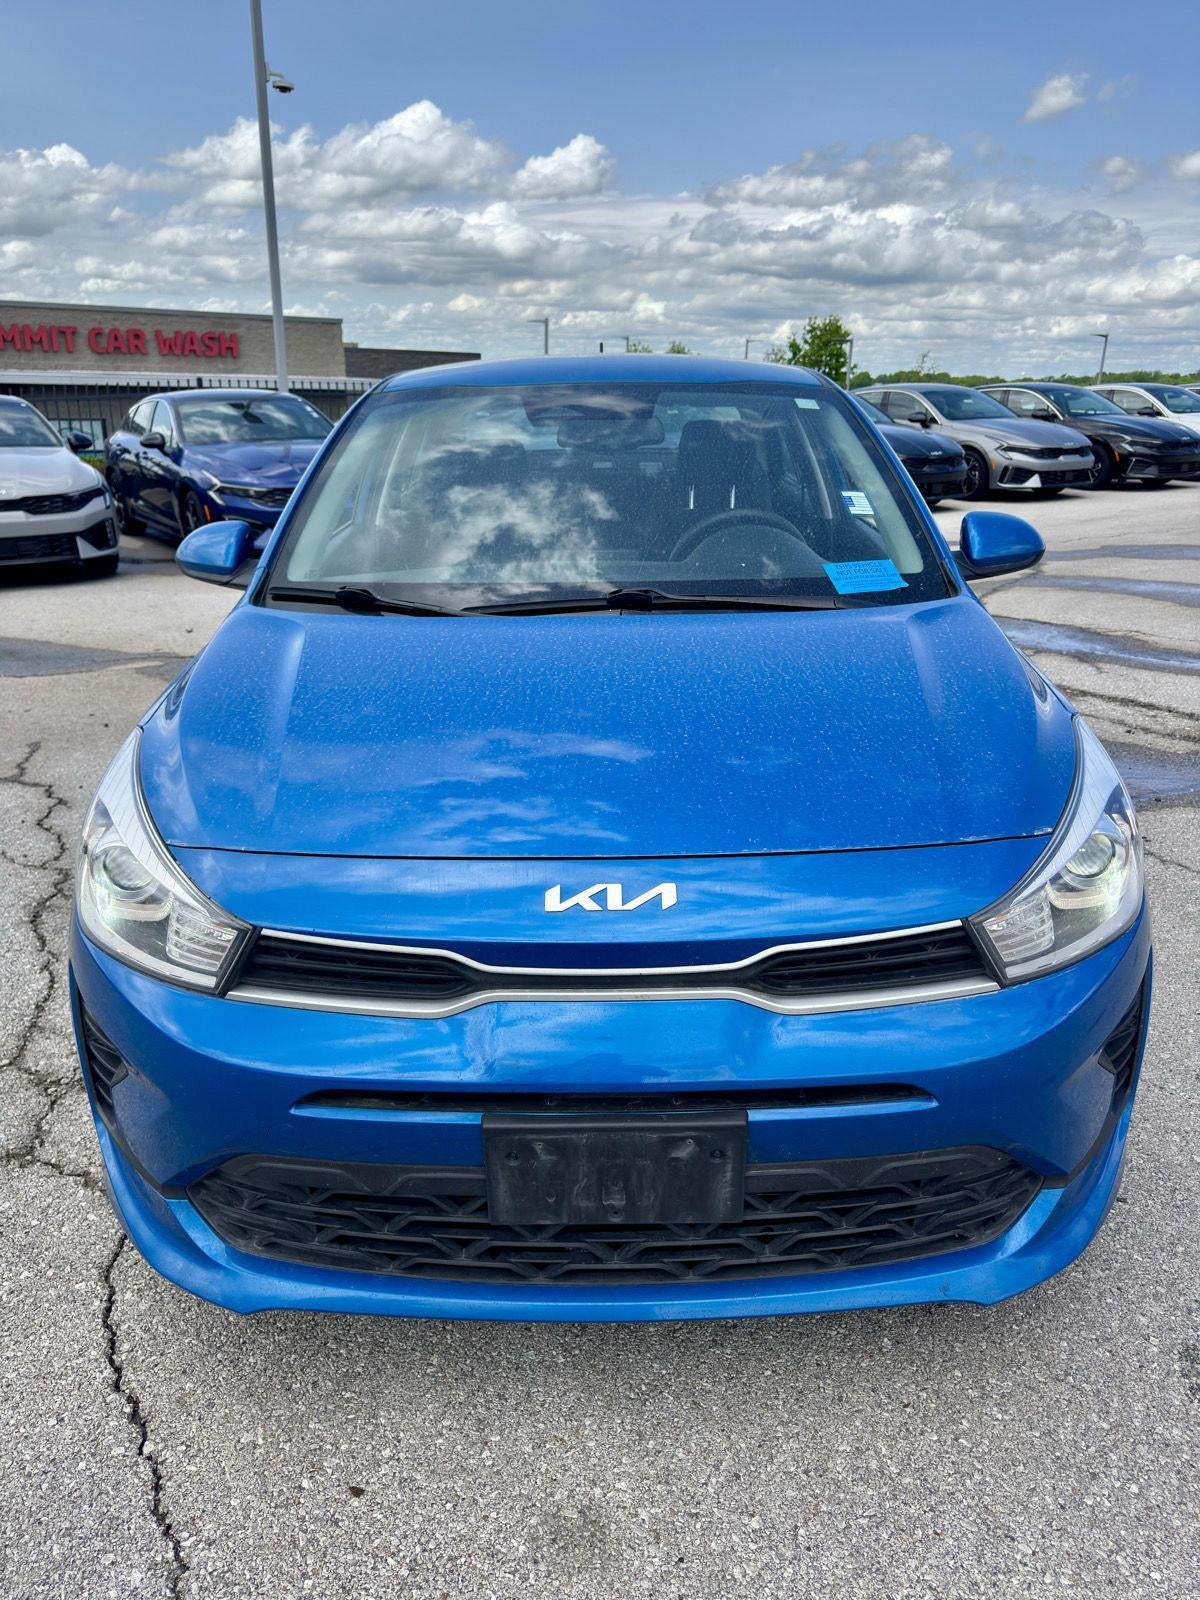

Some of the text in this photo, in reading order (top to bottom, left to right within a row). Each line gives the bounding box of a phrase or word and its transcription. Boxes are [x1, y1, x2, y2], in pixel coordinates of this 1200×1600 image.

[0, 324, 240, 358] MMIT CAR WASH
[545, 882, 678, 912] KIA
